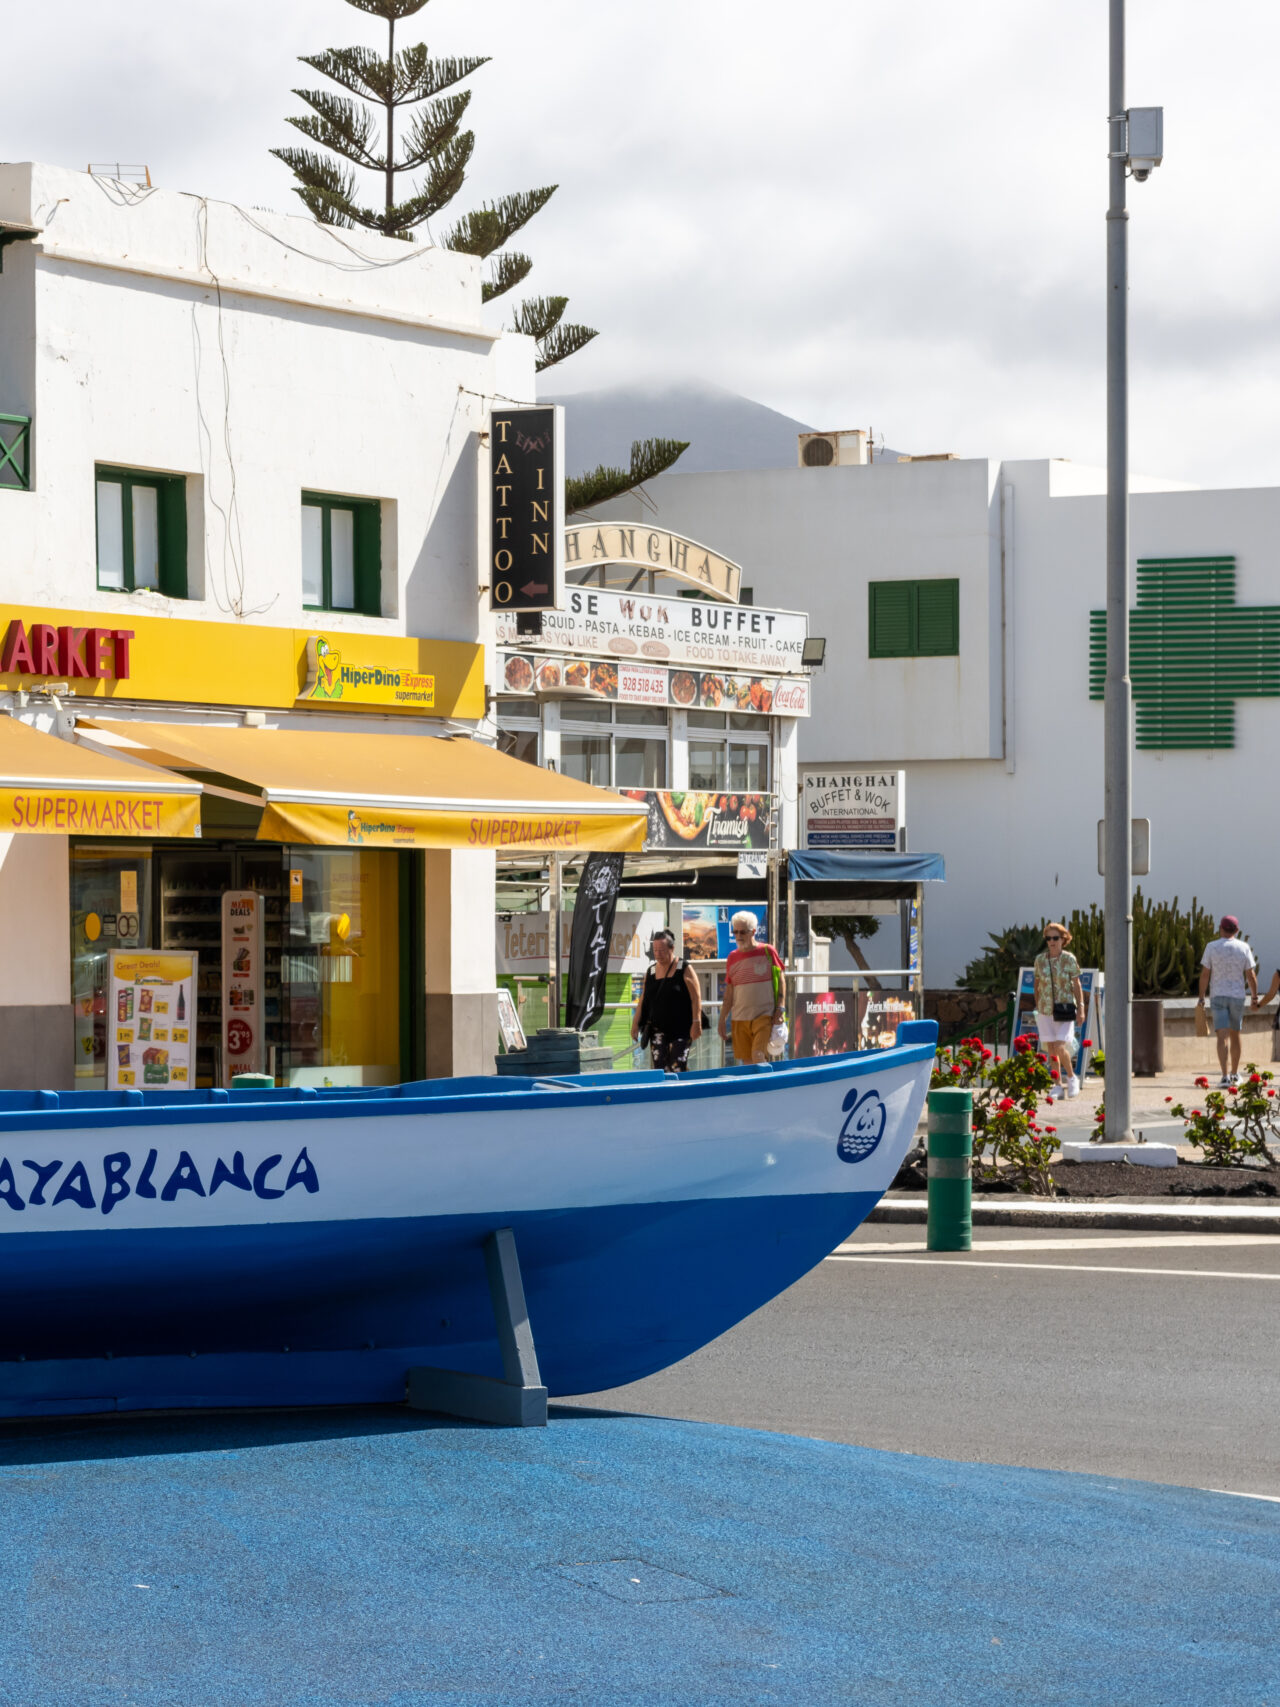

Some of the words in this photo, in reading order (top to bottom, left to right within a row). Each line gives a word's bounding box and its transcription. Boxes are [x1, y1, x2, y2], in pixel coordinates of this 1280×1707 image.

[494, 421, 513, 603] TATTOO
[531, 468, 550, 555] INN
[565, 528, 734, 595] HANGHAI
[691, 607, 776, 635] BUFFET
[541, 614, 575, 630] SQUID
[585, 619, 619, 635] PASTA
[629, 624, 665, 640] KEBAB
[673, 629, 691, 643] ICE
[693, 631, 730, 647] CREAM
[738, 635, 767, 650] FRUIT
[775, 639, 803, 654] CAKE
[554, 632, 574, 647] YOU
[577, 635, 598, 649] LIKE
[686, 645, 714, 660] FOOD
[717, 648, 730, 661] TO
[732, 650, 757, 665] TAKE
[760, 654, 787, 668] AWAY
[340, 666, 401, 688] HiperDino
[405, 673, 433, 690] Express
[623, 676, 636, 691] 928
[637, 678, 650, 692] 518
[650, 679, 664, 694] 435
[395, 690, 433, 702] supermarket
[806, 775, 896, 788] SHANGHAI
[12, 795, 164, 831] SUPERMARKET
[810, 788, 851, 814] BUFFET
[854, 788, 861, 801] &
[865, 790, 891, 813] WOK
[822, 808, 878, 816] INTERNATIONAL
[468, 818, 582, 847] SUPERMARKET
[739, 851, 767, 863] ENTRANCE
[230, 908, 250, 916] DEALS
[504, 923, 549, 959] Teteri
